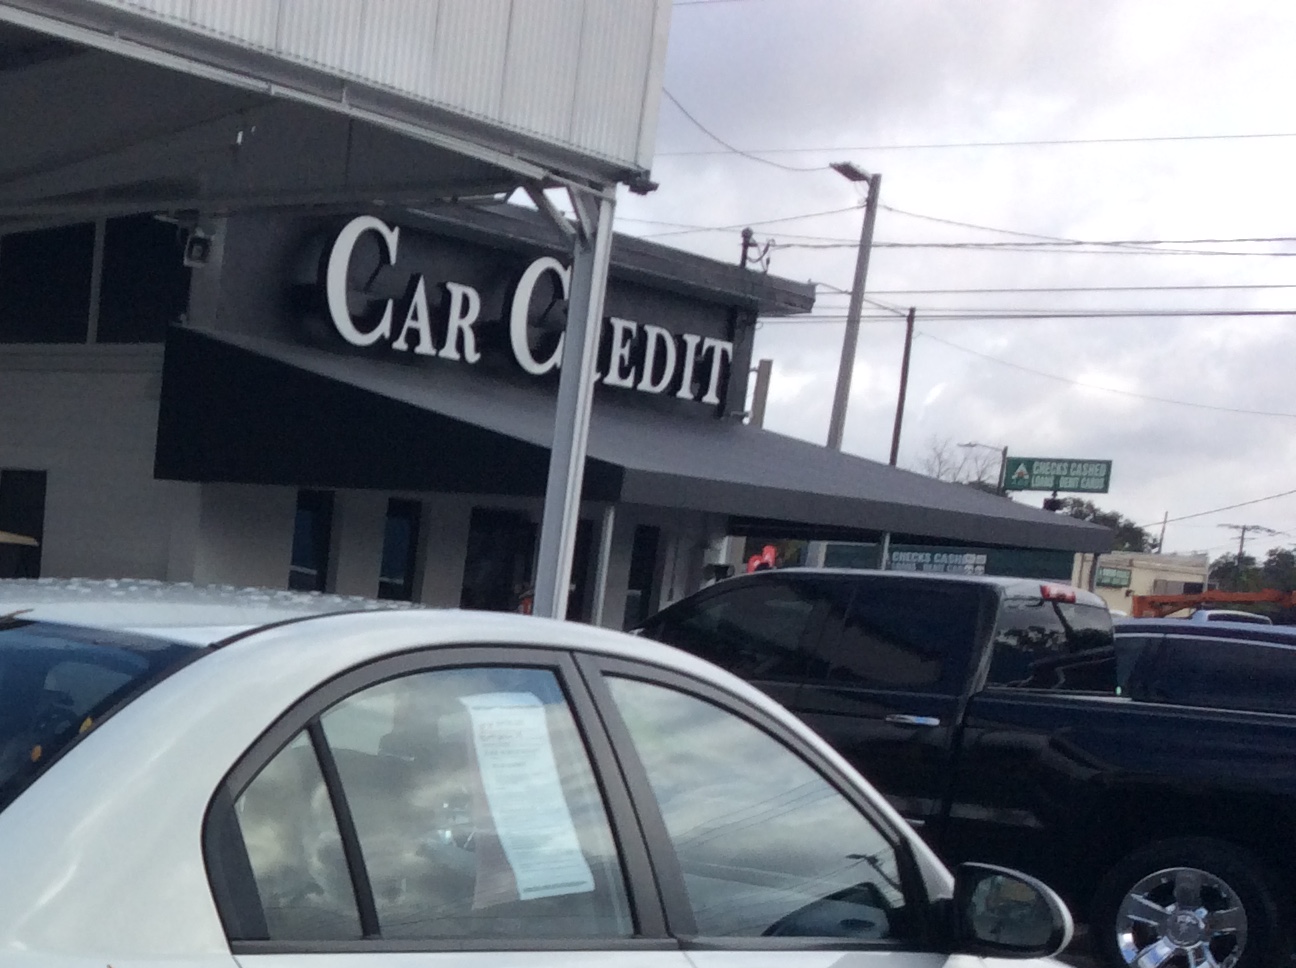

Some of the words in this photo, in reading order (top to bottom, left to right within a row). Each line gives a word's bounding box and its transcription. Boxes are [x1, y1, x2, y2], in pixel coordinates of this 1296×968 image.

[326, 215, 481, 363] CAR
[510, 257, 733, 405] CEDIT
[1032, 461, 1069, 475] CHECKS
[1070, 463, 1107, 477] CASHED
